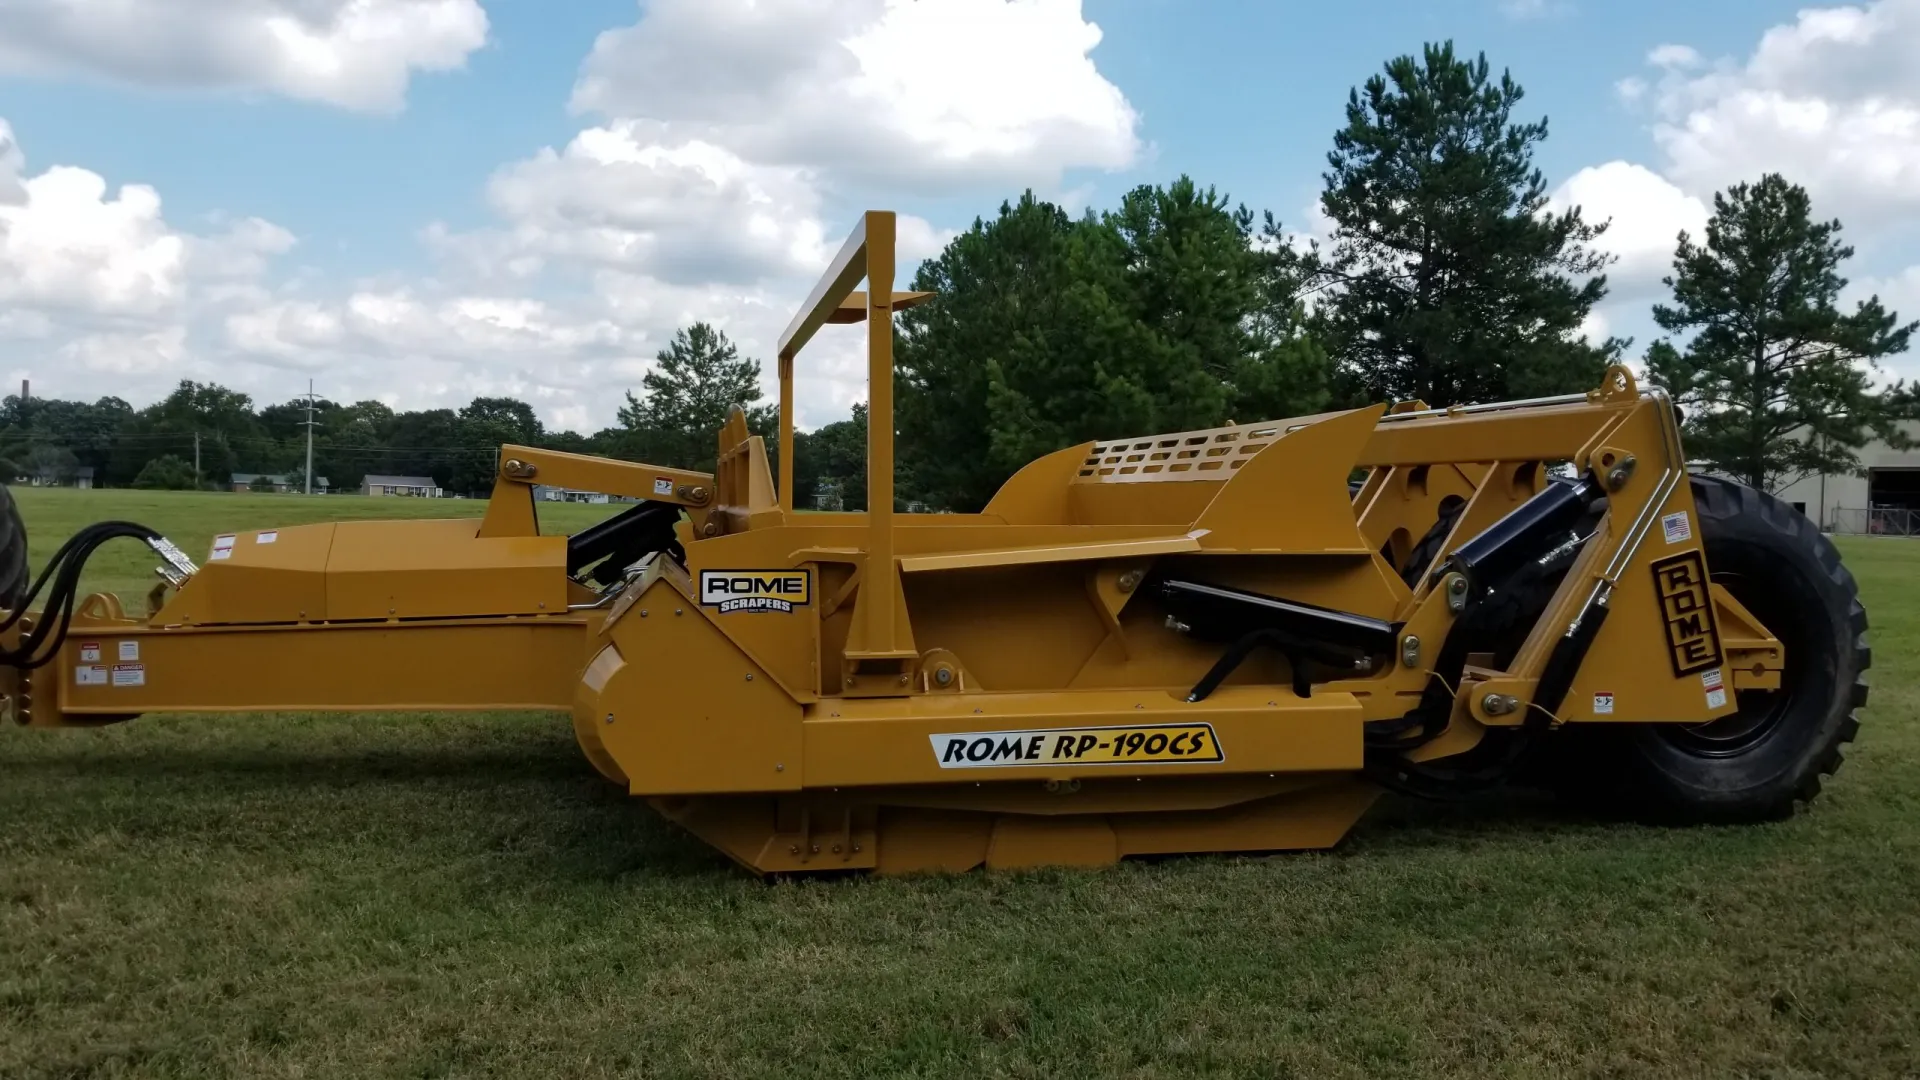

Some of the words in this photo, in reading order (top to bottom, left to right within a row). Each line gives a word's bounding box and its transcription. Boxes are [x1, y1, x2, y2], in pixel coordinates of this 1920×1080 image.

[708, 578, 802, 593] ROME
[721, 598, 791, 612] SCRAPERS
[1668, 564, 1709, 664] ROME
[943, 736, 1045, 762] ROME
[1052, 731, 1205, 759] RP-190CS
